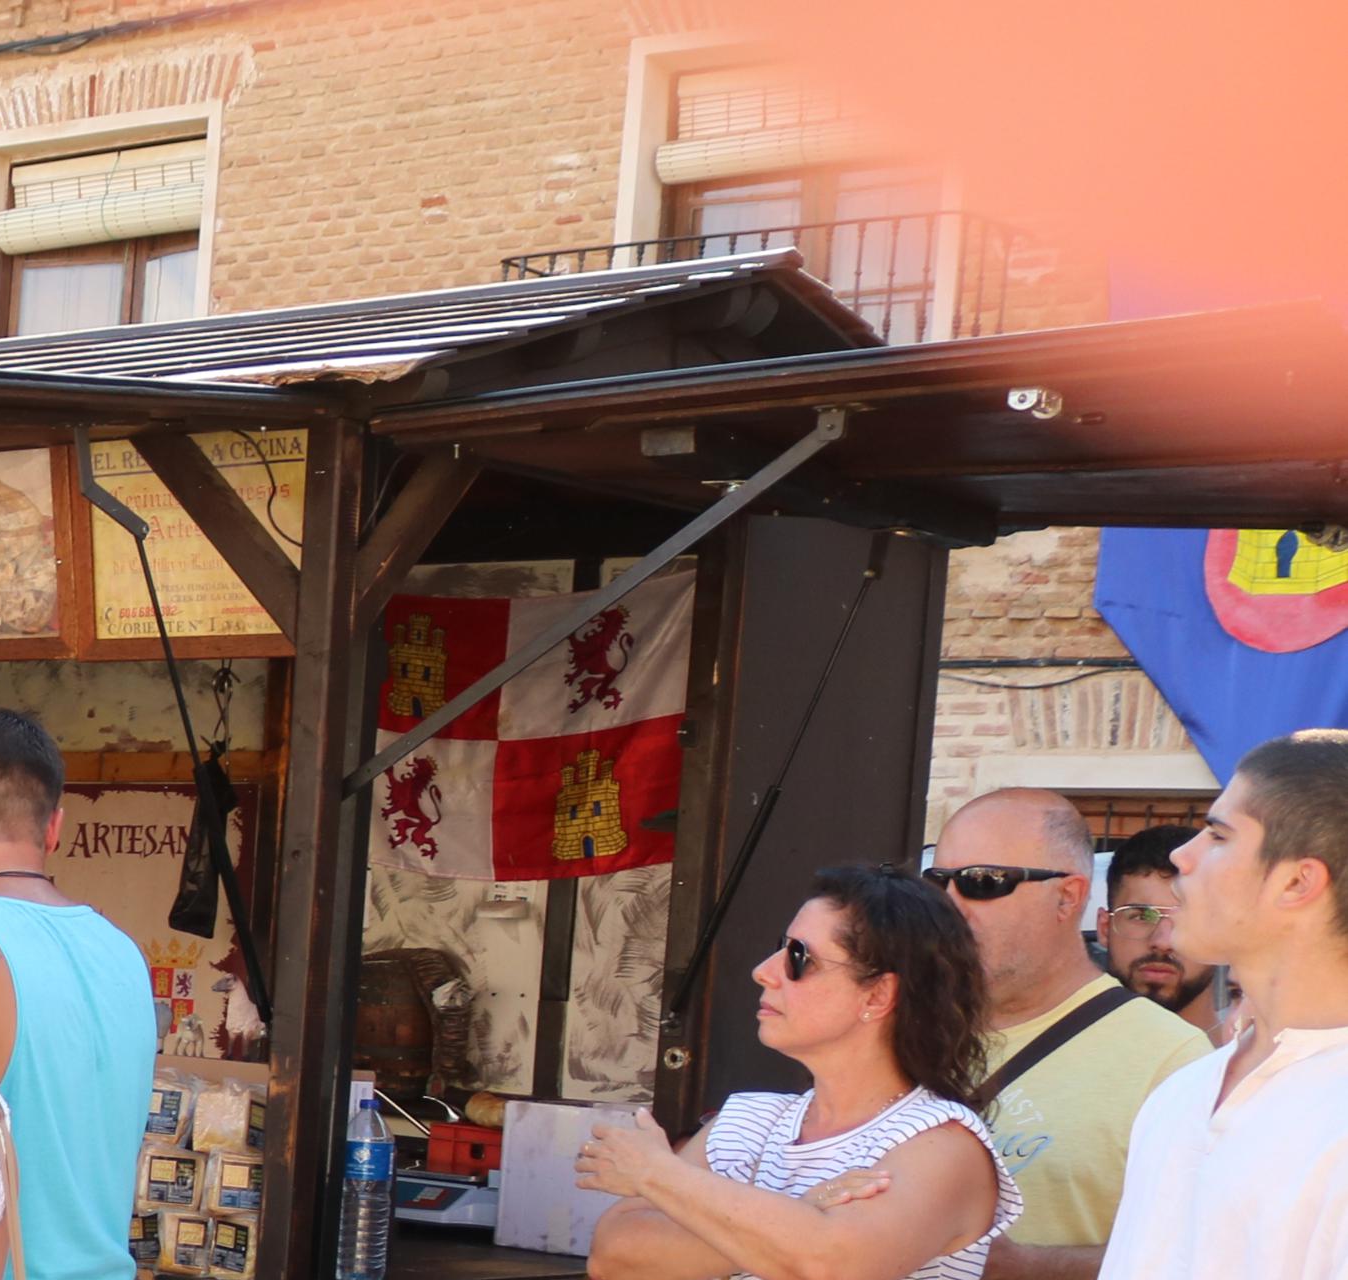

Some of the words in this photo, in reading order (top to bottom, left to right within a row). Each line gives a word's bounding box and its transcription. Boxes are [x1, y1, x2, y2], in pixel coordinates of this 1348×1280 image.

[93, 453, 116, 470] EL
[122, 451, 148, 468] RE
[230, 437, 304, 458] CECINA
[110, 486, 179, 509] Cecina
[147, 515, 205, 542] Artes
[107, 618, 186, 636] C/ORIETE
[66, 820, 195, 858] ARTESAN
